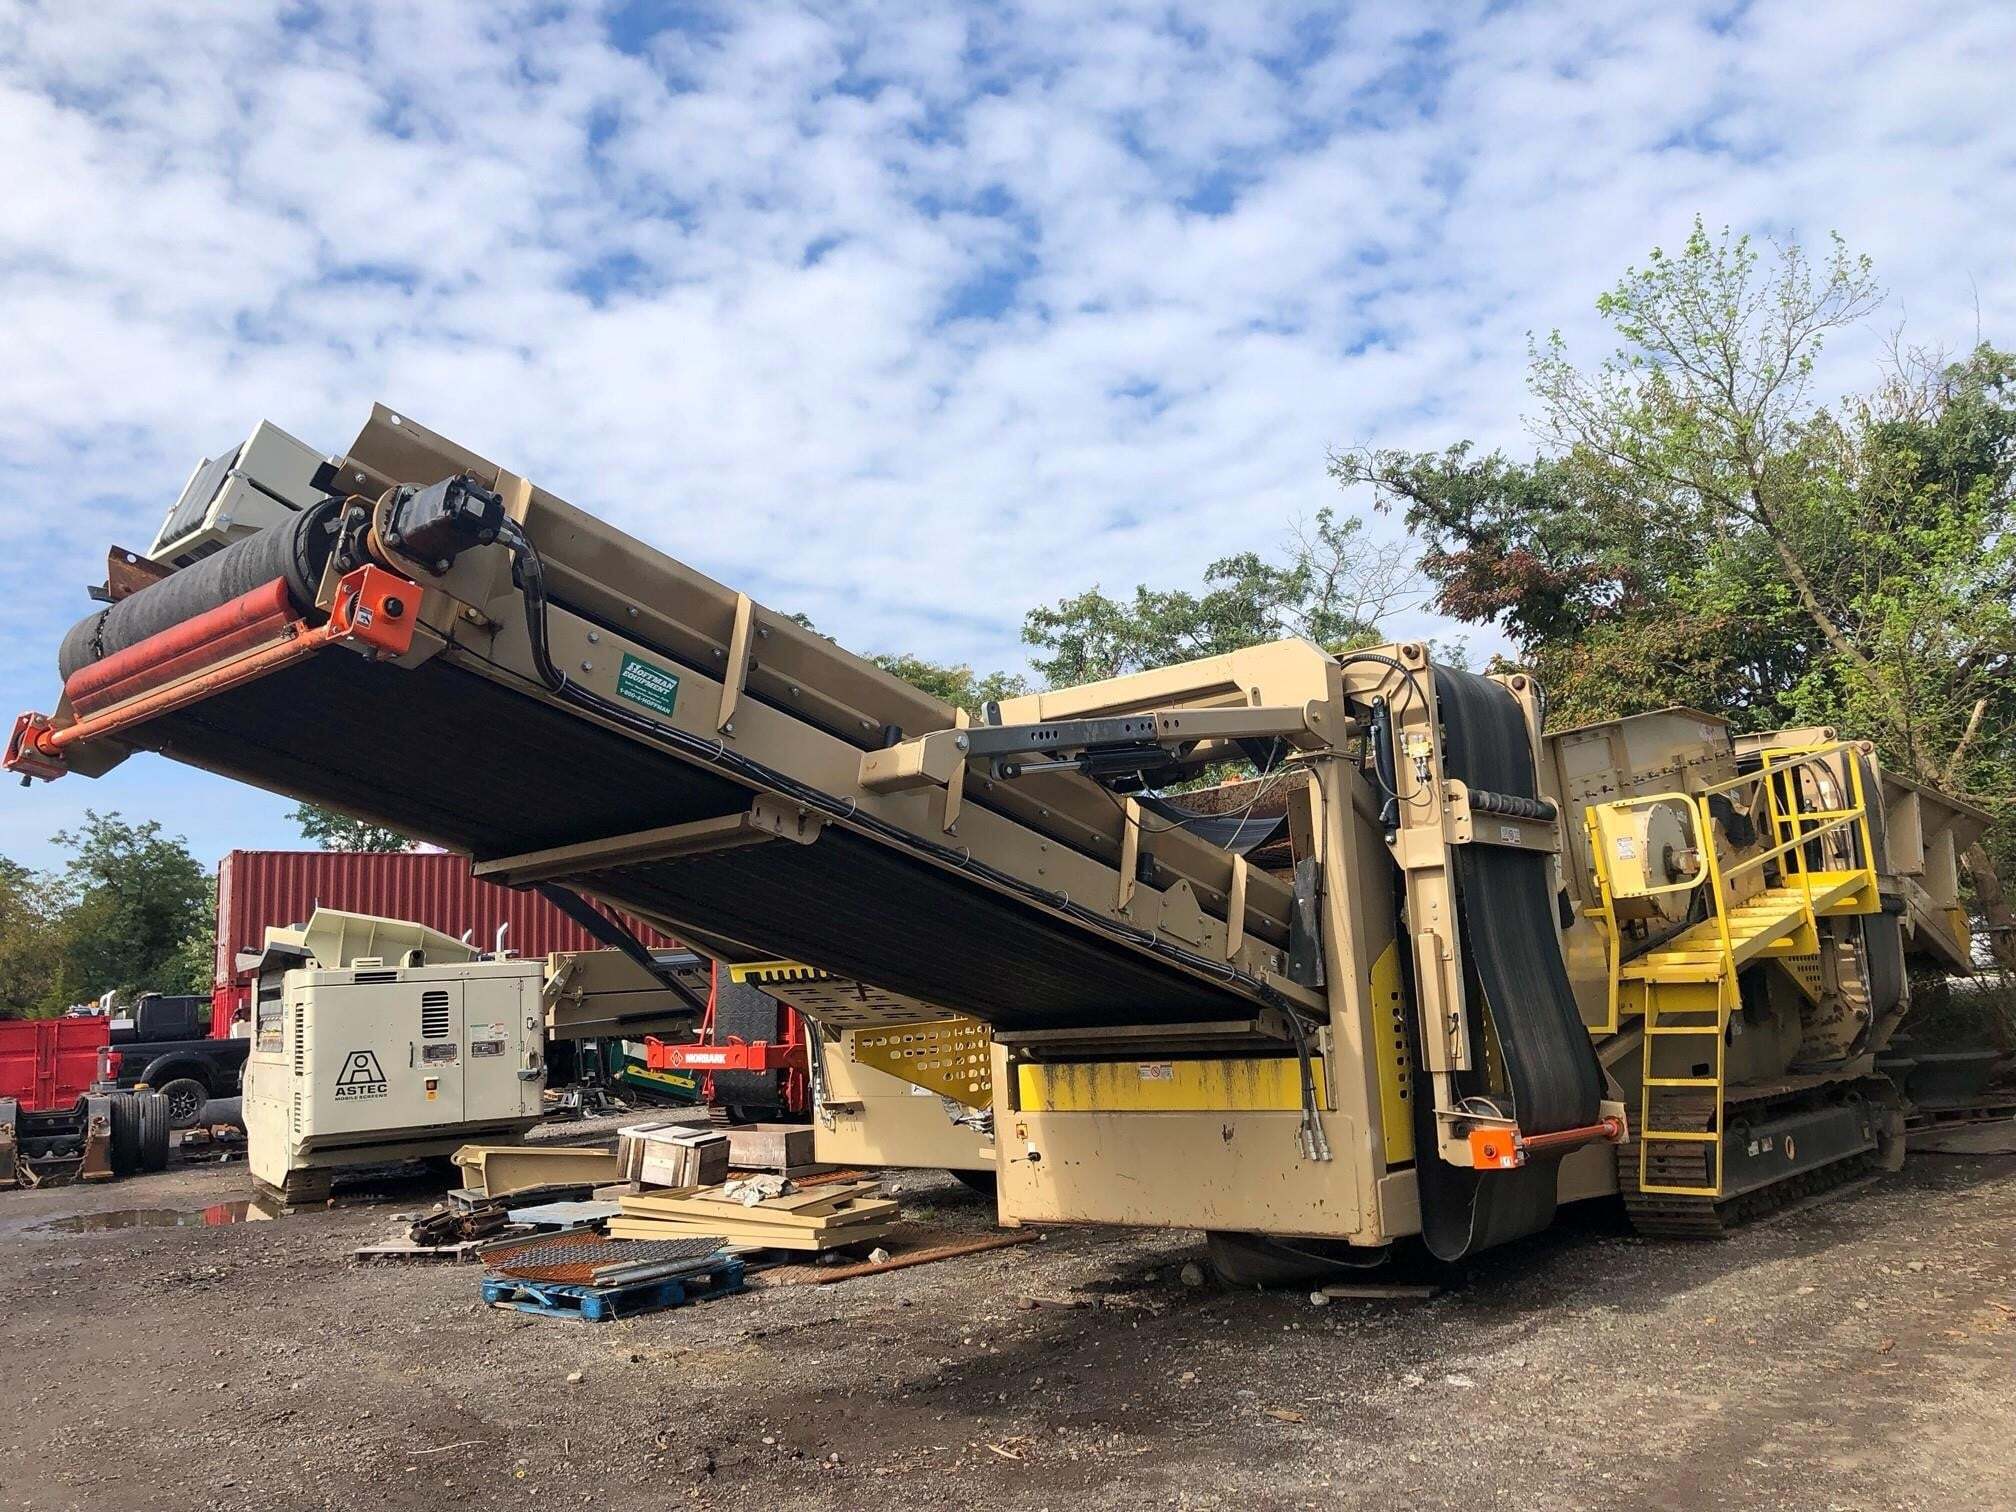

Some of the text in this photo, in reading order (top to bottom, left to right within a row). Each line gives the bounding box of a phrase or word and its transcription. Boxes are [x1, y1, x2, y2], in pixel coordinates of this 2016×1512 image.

[622, 671, 671, 695] EQUIPMENT
[626, 662, 675, 690] HOFFMAN
[620, 688, 671, 714] 1-800-4-HOFFMAN
[335, 1084, 388, 1096] ASTEC
